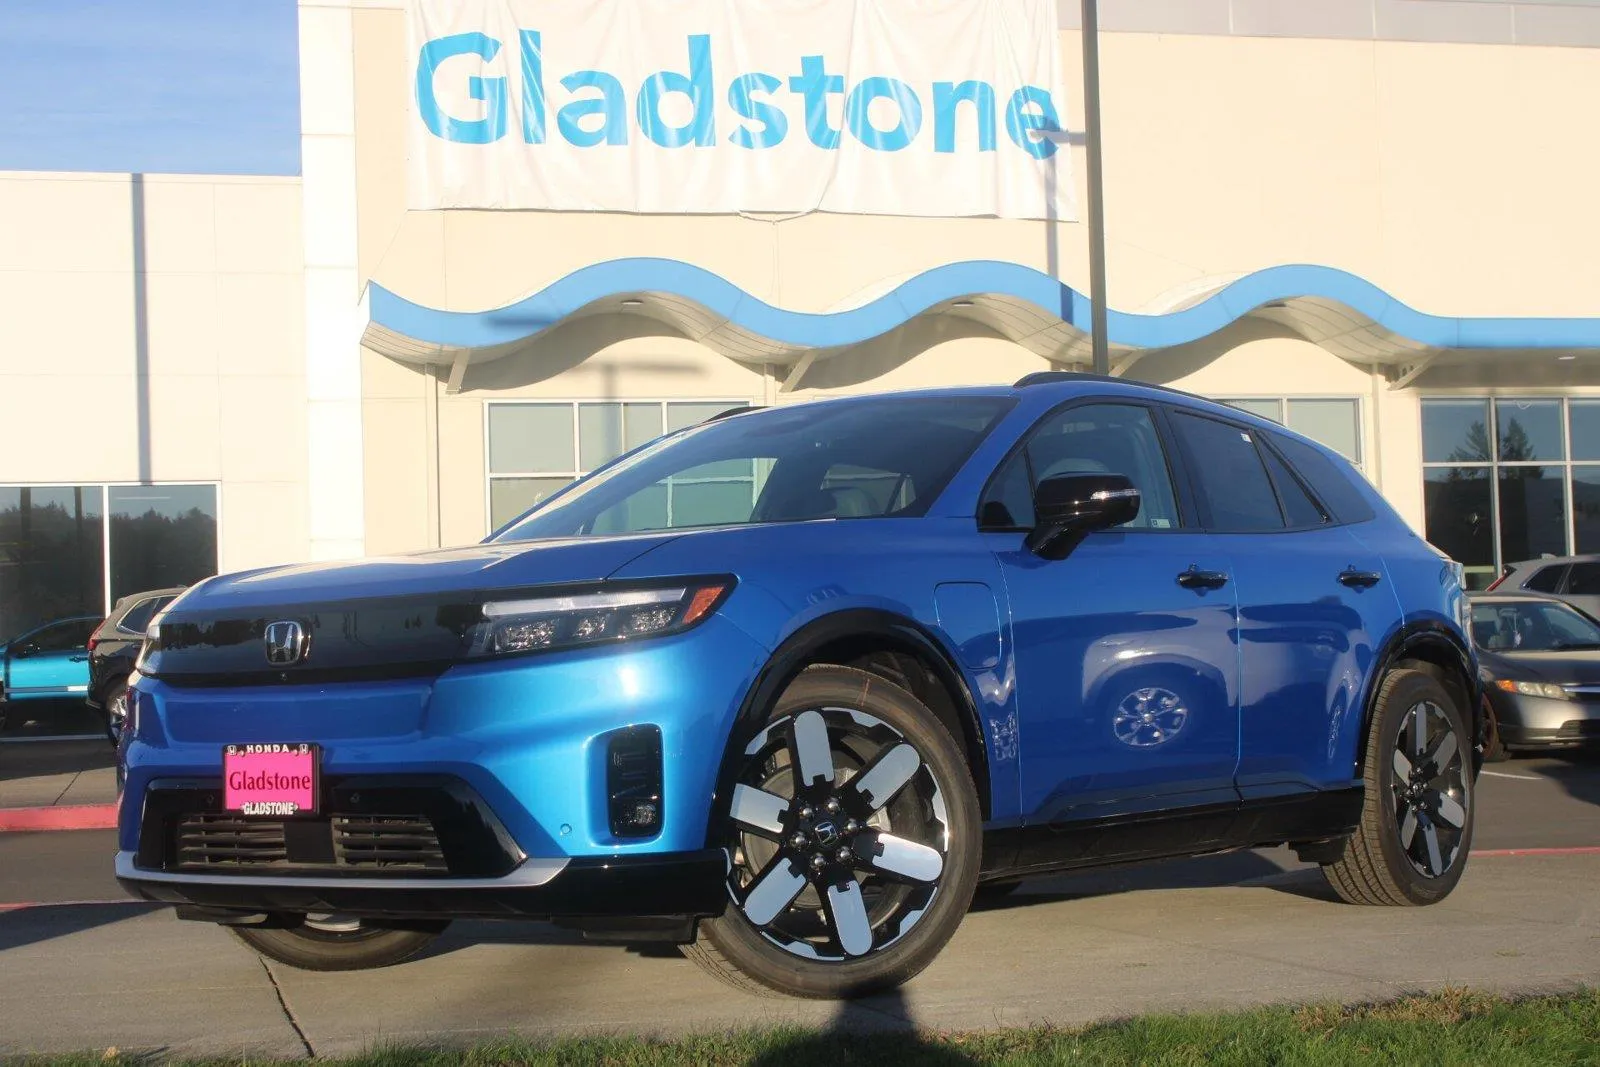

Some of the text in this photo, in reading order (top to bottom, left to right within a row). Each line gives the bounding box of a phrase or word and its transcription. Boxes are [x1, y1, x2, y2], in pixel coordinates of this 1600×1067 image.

[415, 29, 1058, 160] Gladstone
[247, 744, 290, 754] HONDA
[229, 770, 311, 791] Gladstone
[243, 802, 294, 815] GLADSTONE
